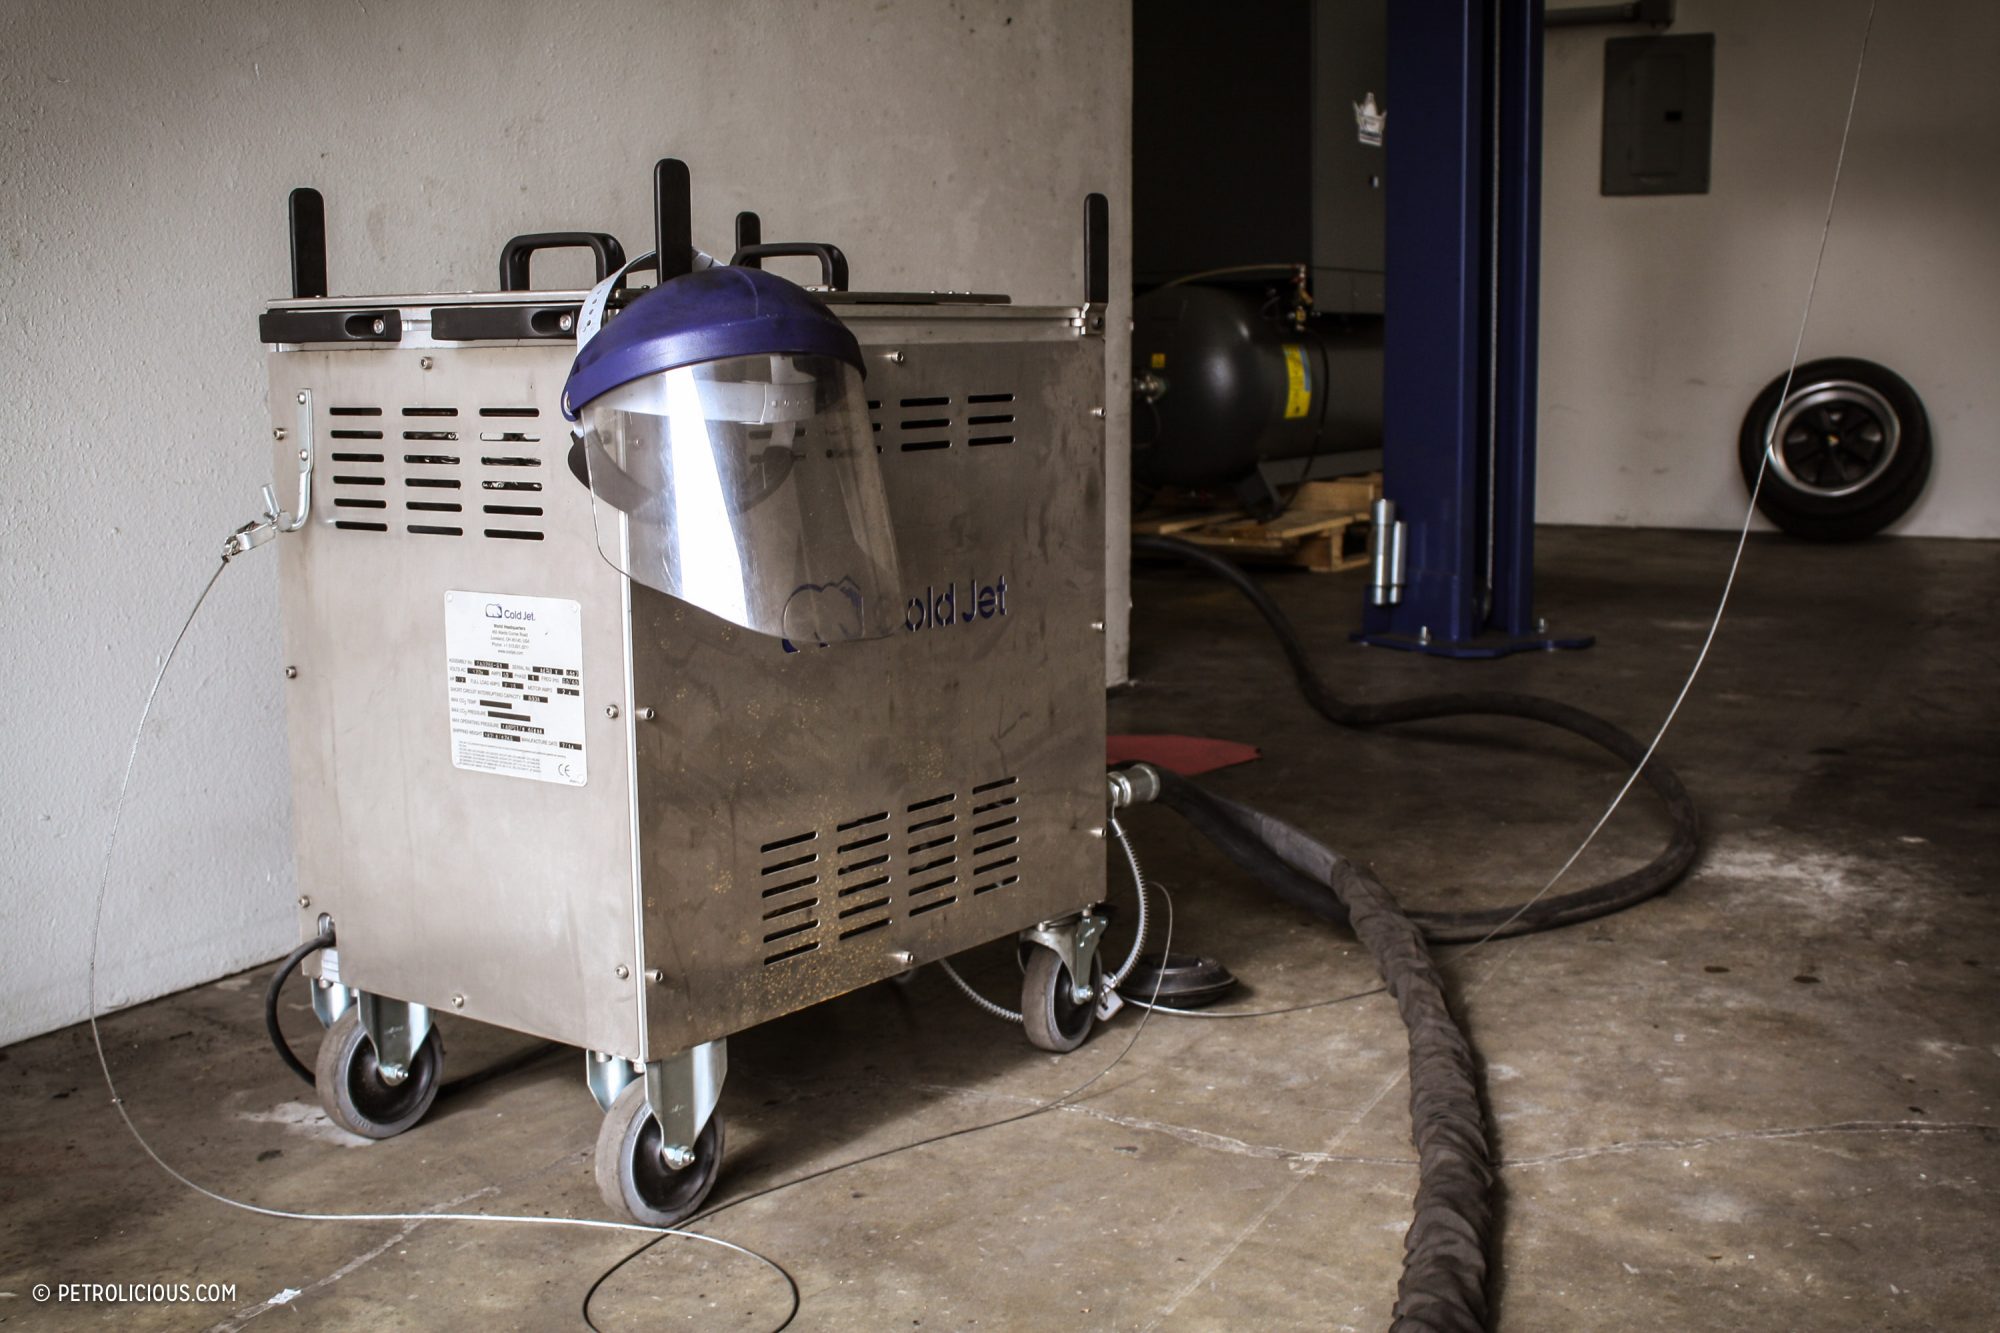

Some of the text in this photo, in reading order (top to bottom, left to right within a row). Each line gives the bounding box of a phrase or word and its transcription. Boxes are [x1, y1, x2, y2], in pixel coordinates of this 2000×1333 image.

[503, 609, 522, 620] Cold
[904, 575, 1008, 633] old Jet
